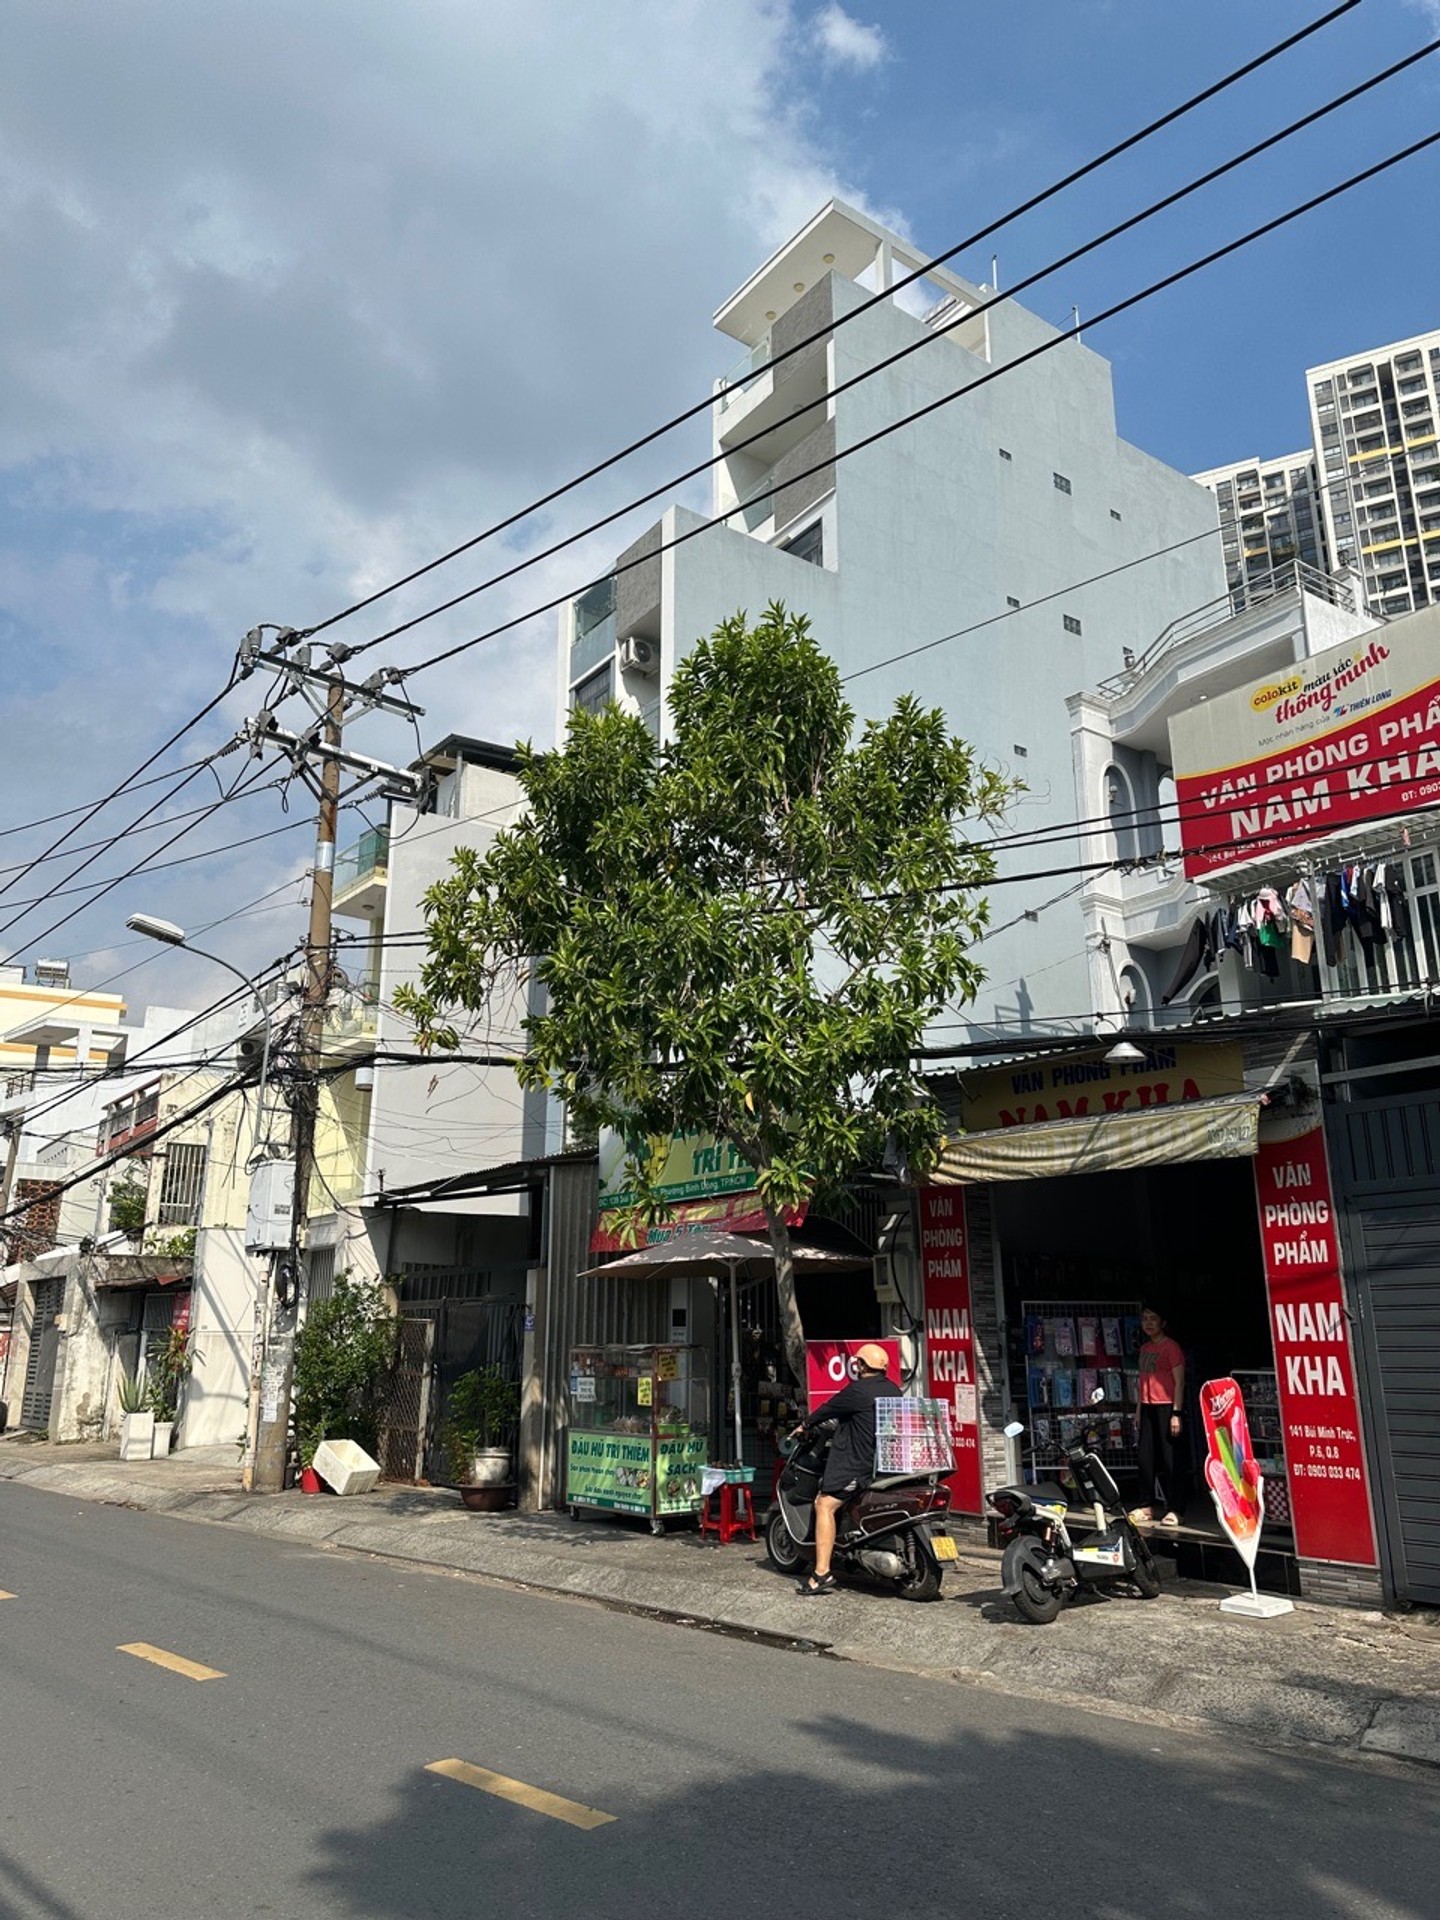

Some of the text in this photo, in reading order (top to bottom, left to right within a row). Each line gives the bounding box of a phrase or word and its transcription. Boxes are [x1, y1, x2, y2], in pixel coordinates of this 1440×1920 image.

[1275, 642, 1390, 723] thông minh
[1200, 774, 1257, 810] VĂN
[1266, 733, 1369, 786] PHÒNG
[1230, 740, 1440, 839] NAM KHA
[1011, 1066, 1044, 1095] VĂN
[1051, 1057, 1110, 1088] PHÒNG
[1272, 1160, 1312, 1189] VĂN
[929, 1195, 953, 1217] VĂN
[1265, 1195, 1329, 1228] PHÒNG
[923, 1224, 963, 1248] PHÒNG
[1273, 1230, 1328, 1266] PHẨM
[928, 1251, 962, 1278] PHẨM
[928, 1308, 970, 1340] NAM
[1275, 1301, 1344, 1343] NAM
[932, 1350, 970, 1383] KHA
[1285, 1355, 1347, 1397] KHA
[660, 1438, 704, 1458] ĐẬU HỦ
[1289, 1425, 1303, 1437] 141
[1304, 1425, 1317, 1438] Bùi
[1317, 1426, 1336, 1439] Minh
[666, 1462, 697, 1479] SẠCH
[1307, 1464, 1327, 1478] 0903
[1328, 1465, 1344, 1479] 033
[1345, 1467, 1361, 1480] 474
